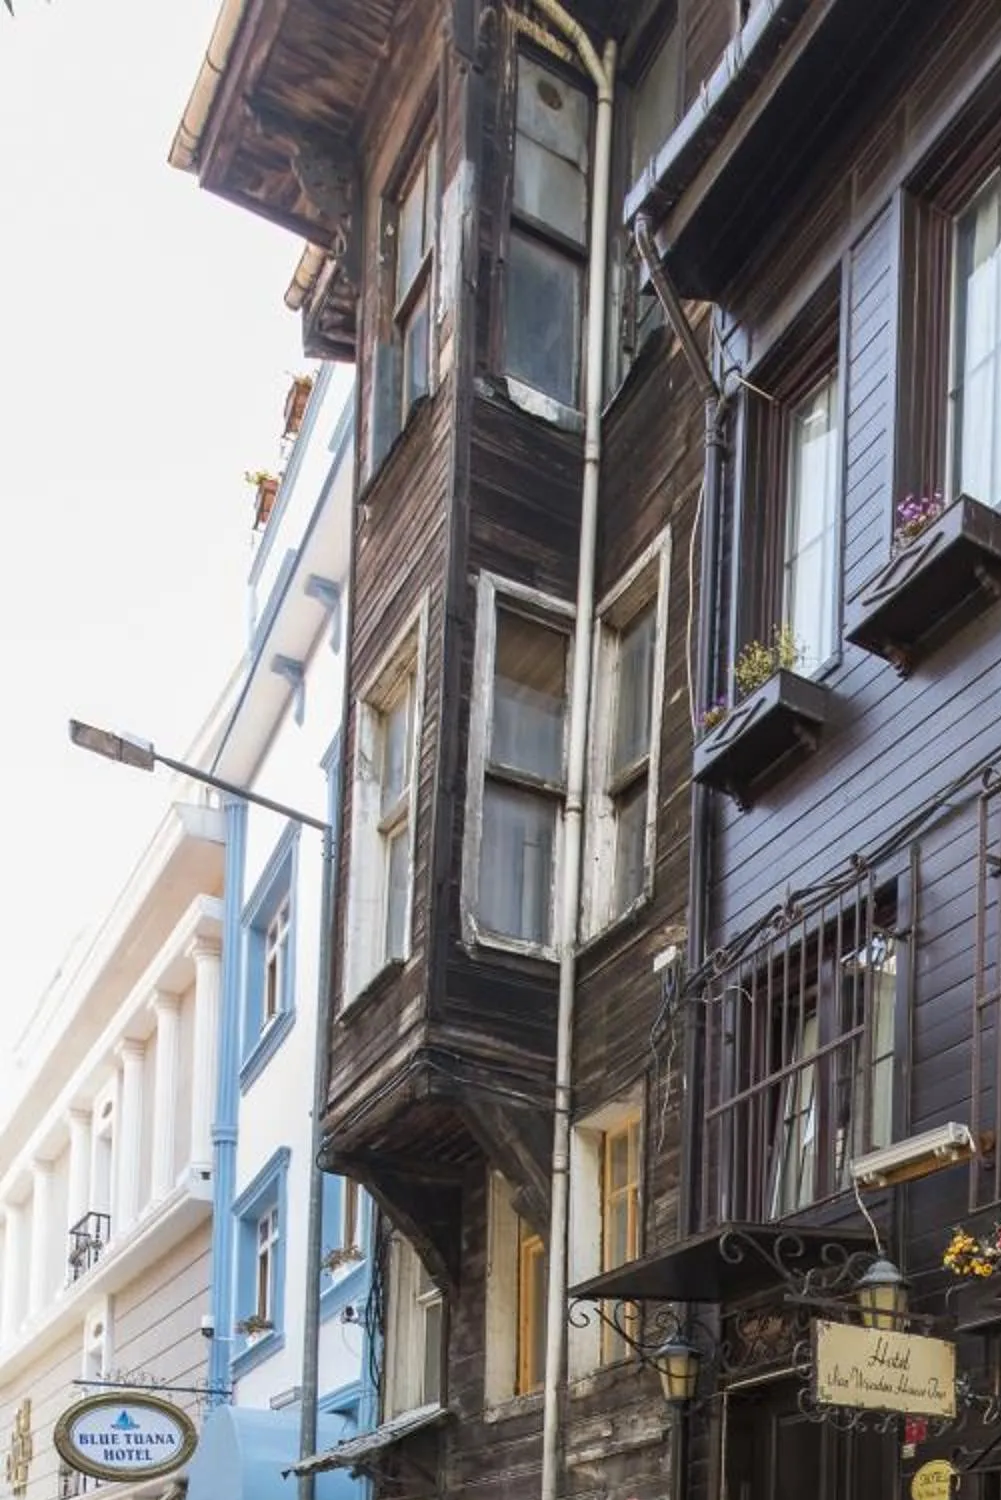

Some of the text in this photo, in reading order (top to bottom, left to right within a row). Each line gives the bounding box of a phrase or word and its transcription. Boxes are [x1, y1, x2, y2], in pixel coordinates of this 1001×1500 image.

[867, 1336, 911, 1370] Hotel
[79, 1433, 175, 1445] BLUE TUANA
[103, 1448, 152, 1460] HOTEL
